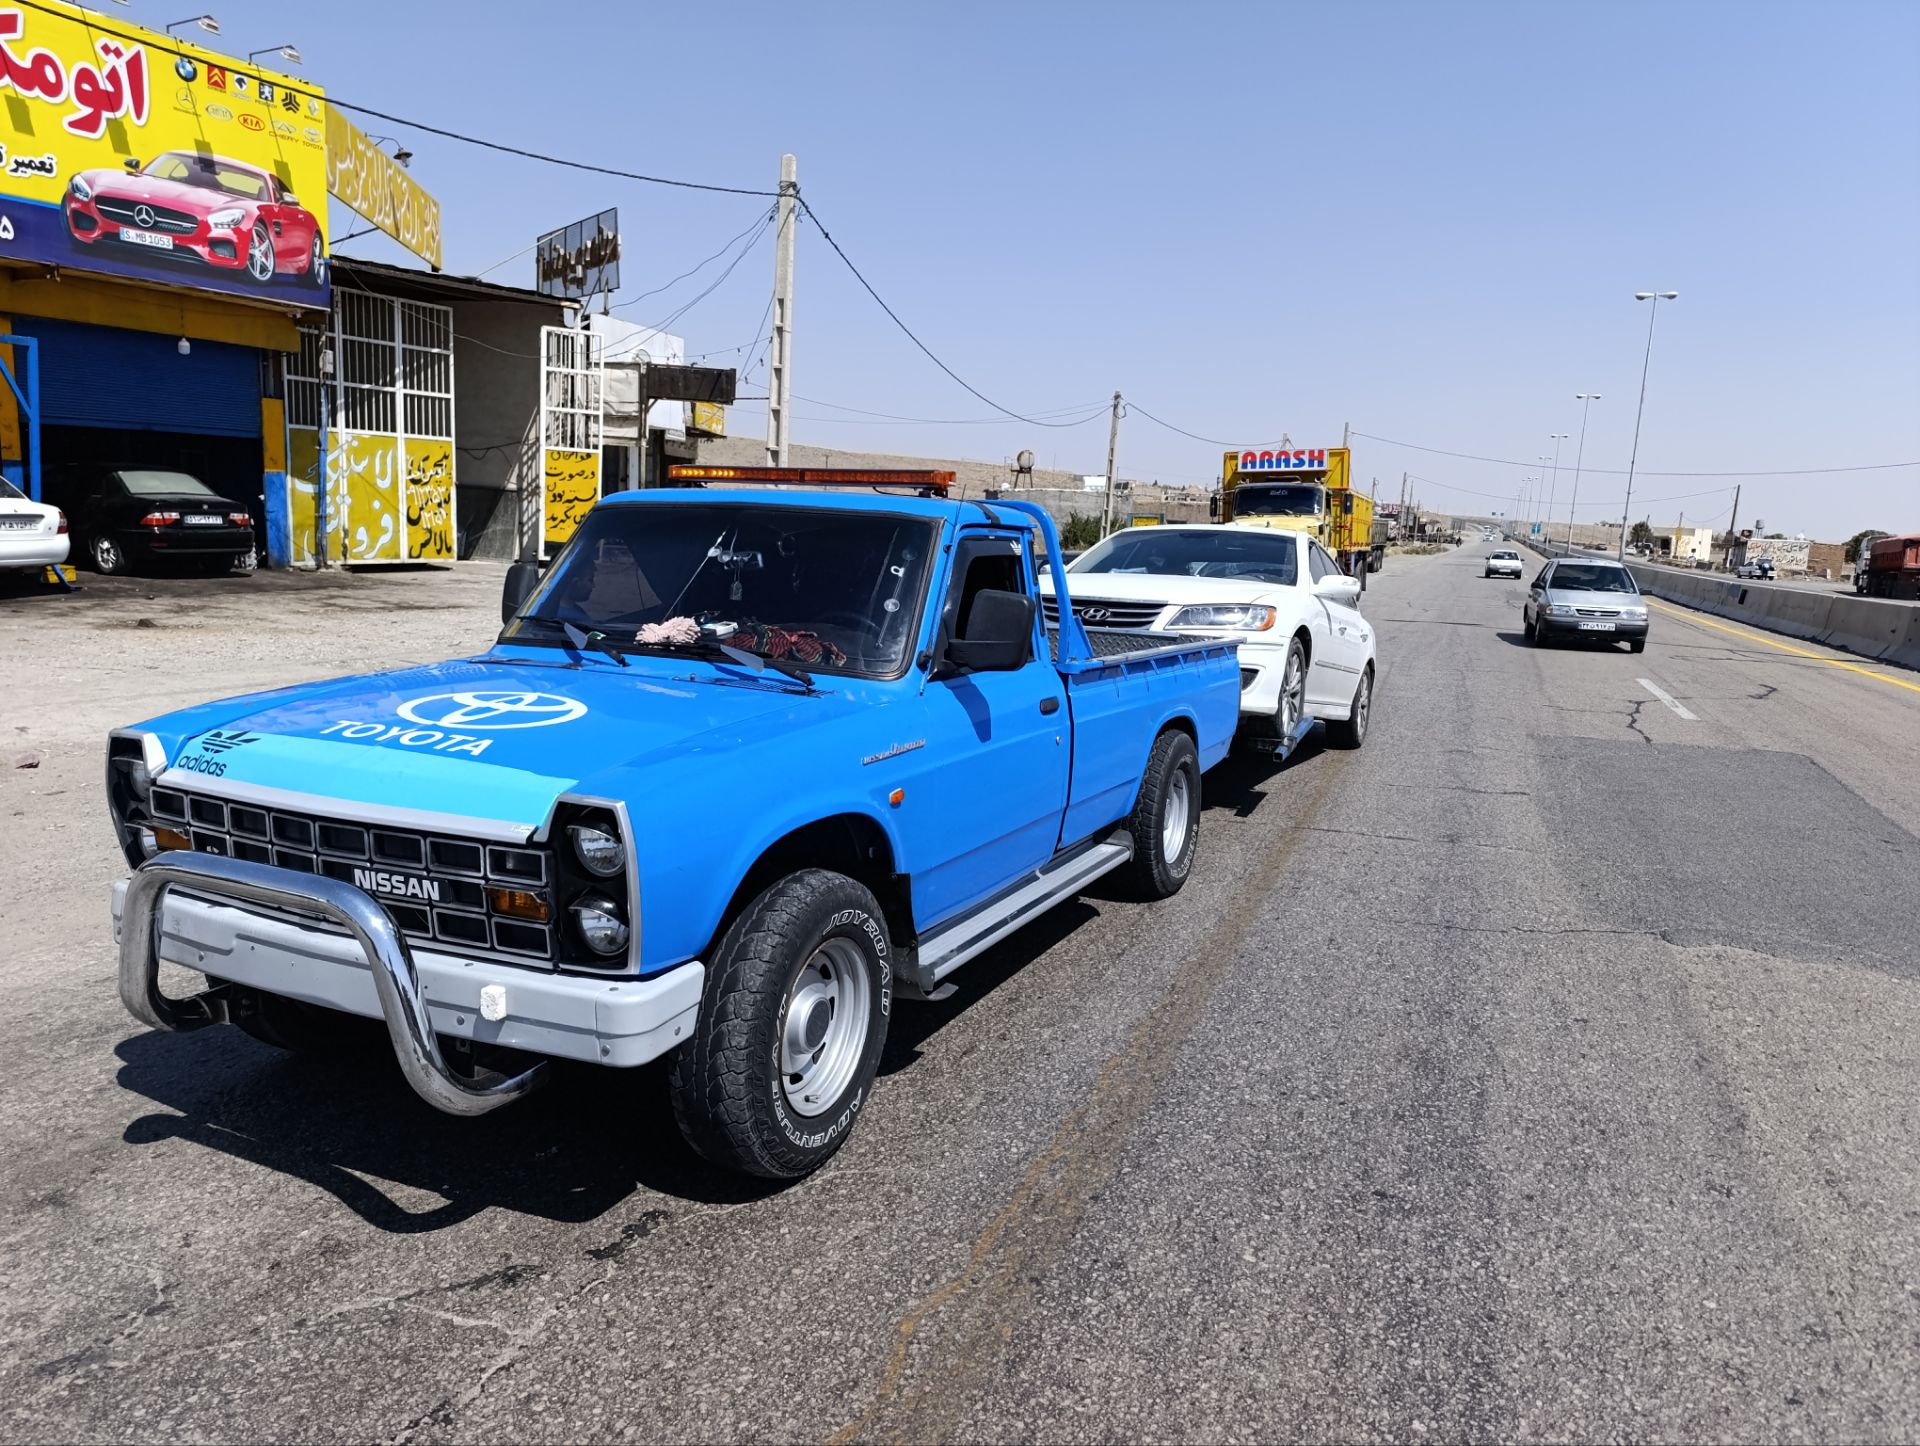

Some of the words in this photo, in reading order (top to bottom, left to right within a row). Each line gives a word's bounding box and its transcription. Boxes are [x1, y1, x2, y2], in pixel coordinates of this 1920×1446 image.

[242, 115, 262, 129] KIA
[302, 140, 324, 151] TOYOTA
[147, 234, 172, 249] 1053
[1241, 449, 1326, 470] ARASH
[319, 719, 494, 758] TOYOTA
[178, 749, 228, 778] adidas
[353, 867, 441, 902] NISSAN
[822, 909, 890, 1017] JOYROAD
